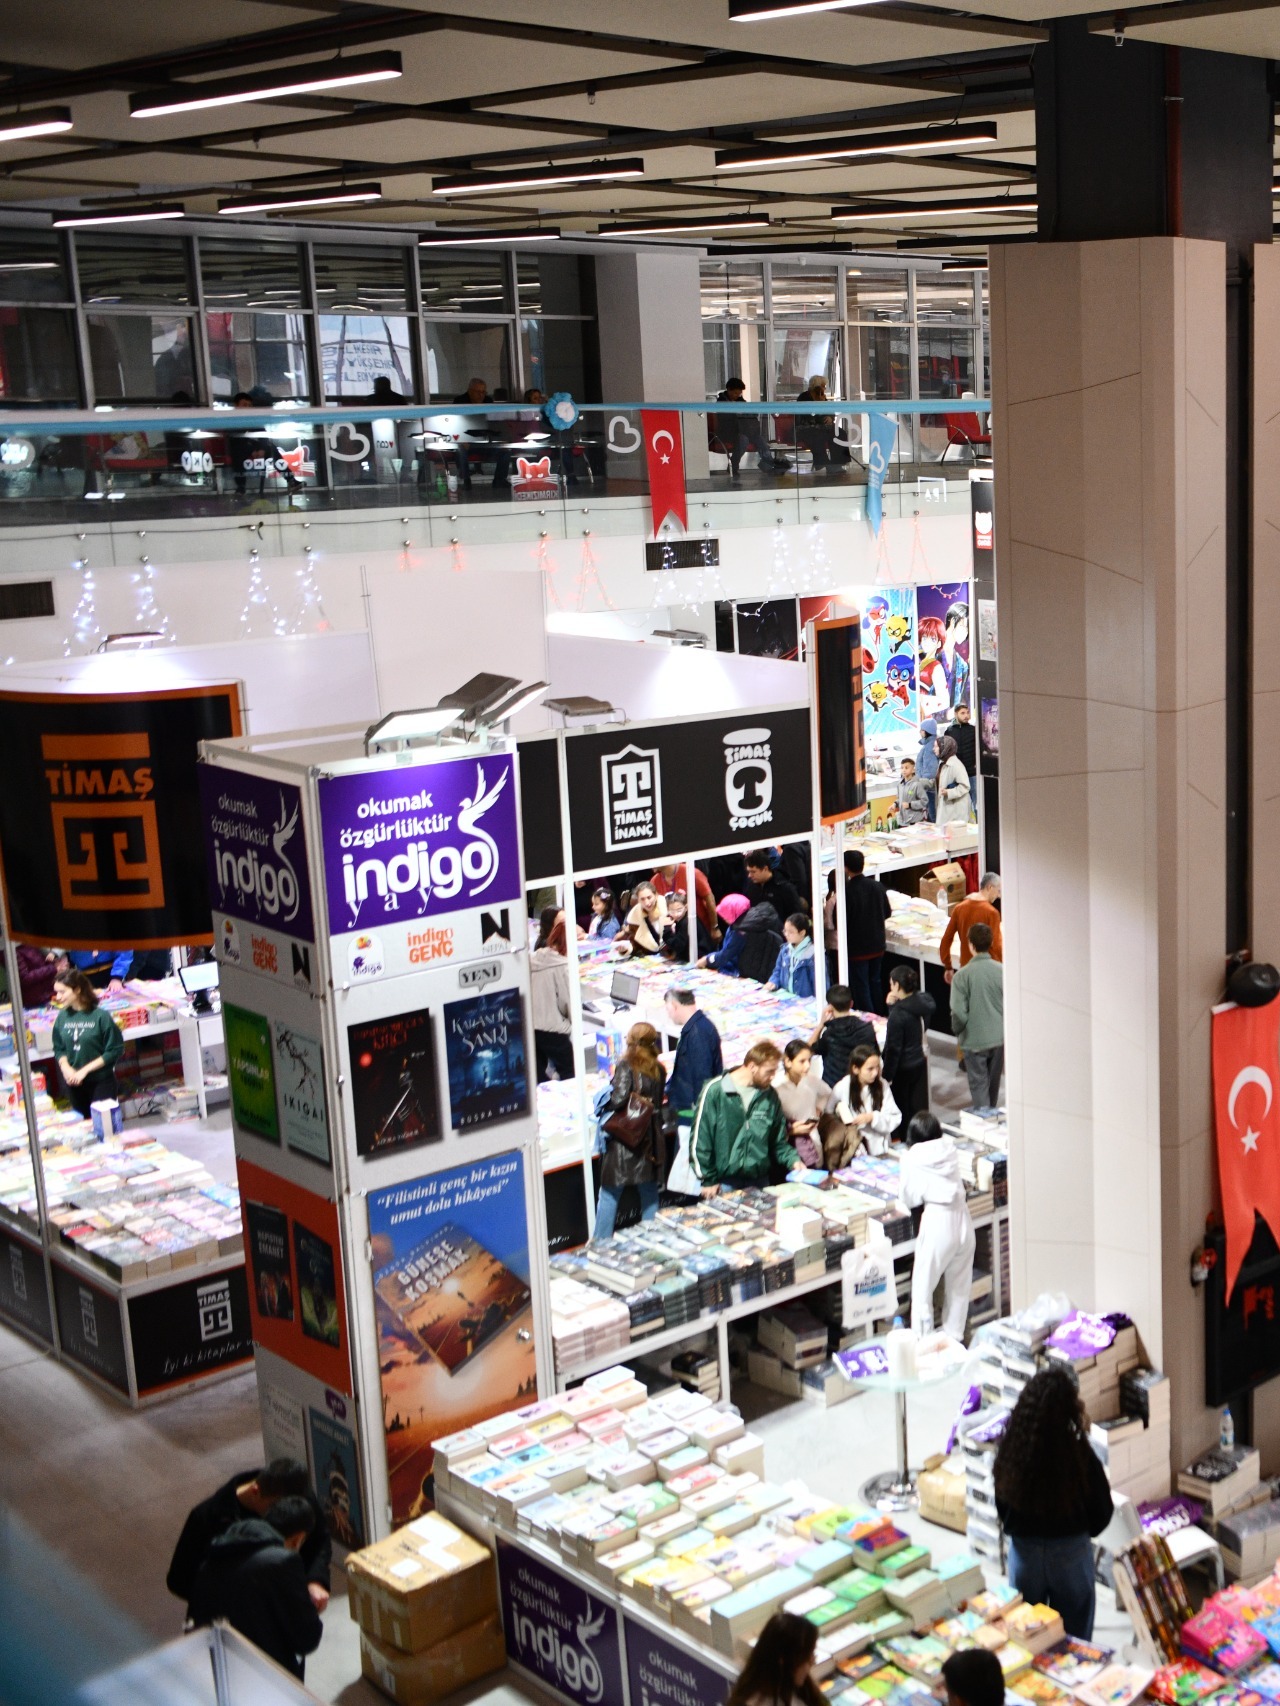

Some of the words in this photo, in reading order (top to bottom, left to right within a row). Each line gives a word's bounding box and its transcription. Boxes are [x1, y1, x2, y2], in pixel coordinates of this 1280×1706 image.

[724, 744, 771, 765] TİMAŞ
[45, 762, 154, 800] TİMAŞ
[218, 793, 258, 818] okumak
[357, 789, 434, 818] okumak
[614, 808, 653, 826] TİMAŞ
[340, 813, 452, 848] özgürlüktür
[614, 824, 653, 841] İNANÇ
[729, 809, 773, 832] ÇOCUK
[214, 838, 296, 915] indigo
[342, 841, 493, 904] indigo
[407, 928, 454, 947] indigo
[409, 941, 454, 964] GENÇ
[462, 965, 497, 984] YENİ
[439, 1176, 468, 1194] genç
[471, 1170, 488, 1183] bir
[490, 1161, 518, 1178] kızın
[390, 1207, 422, 1226] umut
[425, 1198, 451, 1215] dolu
[398, 1240, 455, 1286] GÜNEŞE
[404, 1248, 470, 1301] KOŞMAK
[197, 1289, 231, 1308] TİMAŞ
[518, 1568, 561, 1603] okumak
[512, 1601, 599, 1692] indigo
[648, 1650, 698, 1691] okumak
